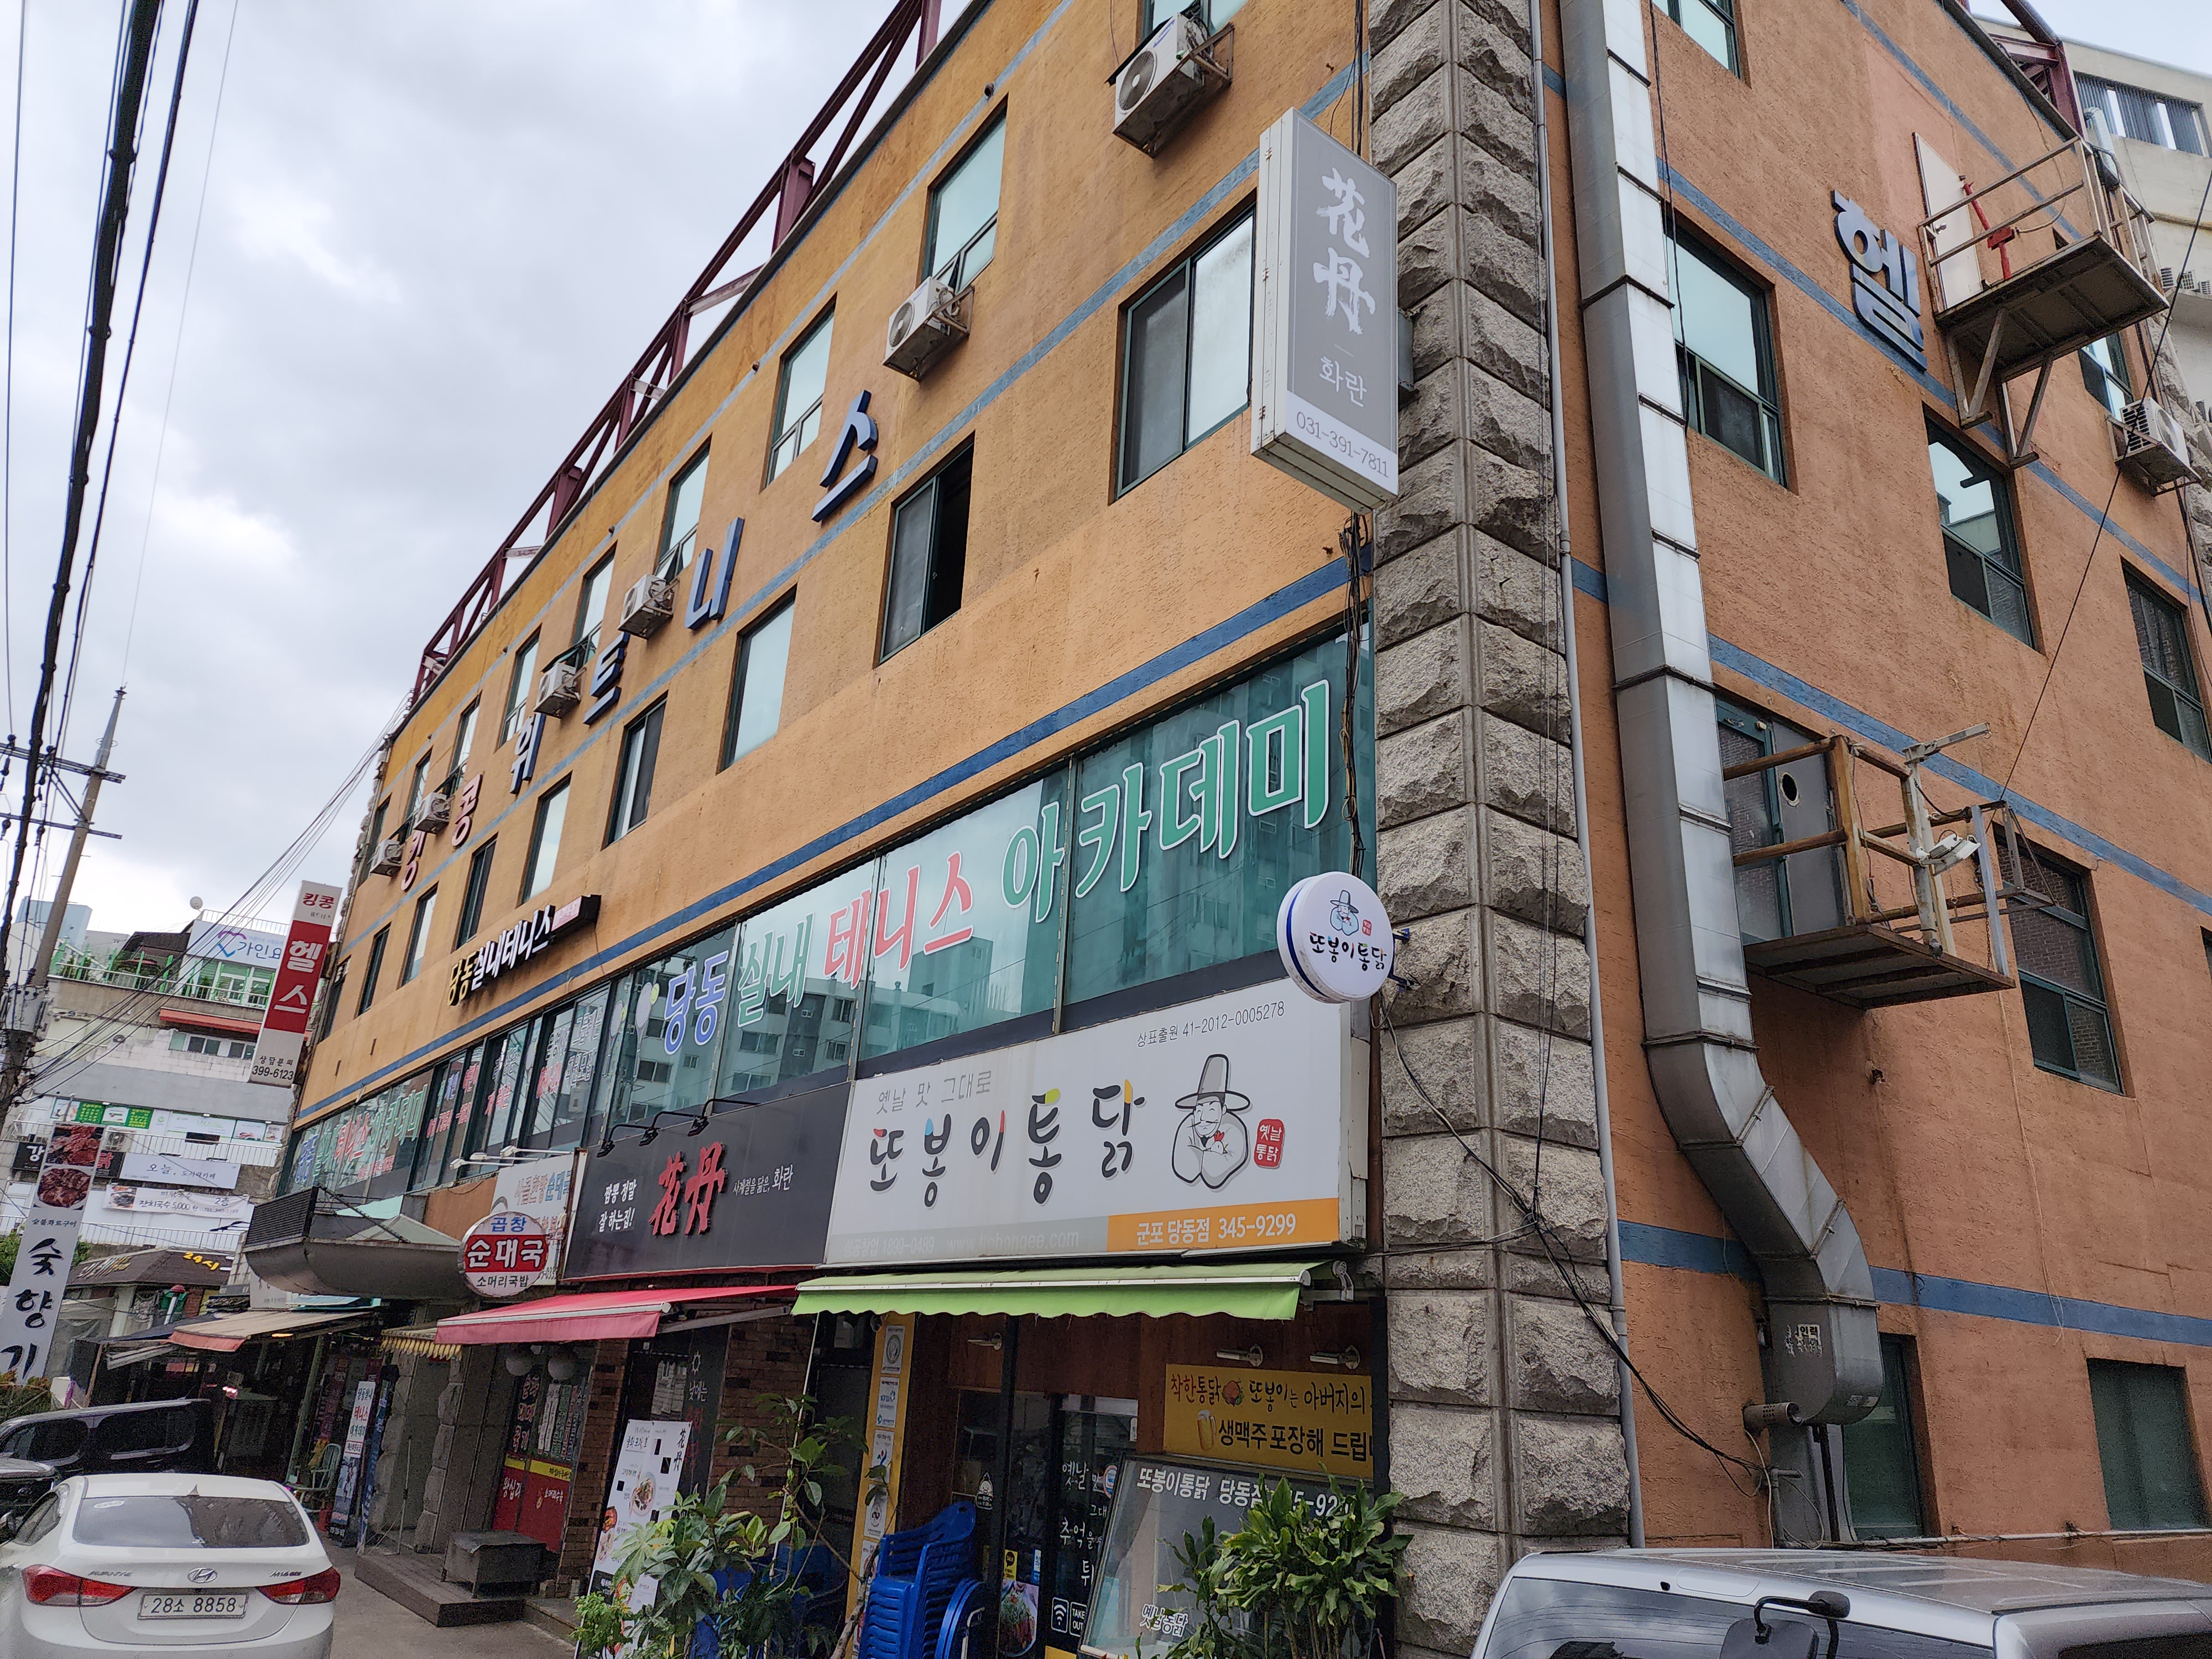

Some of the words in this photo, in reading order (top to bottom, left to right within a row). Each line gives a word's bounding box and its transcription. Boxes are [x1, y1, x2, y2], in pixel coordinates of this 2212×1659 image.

[1830, 189, 1927, 372] 헬
[1319, 356, 1367, 408] 화란
[1296, 411, 1390, 479] 031-391-7811
[664, 949, 729, 1055] 당동
[737, 911, 814, 1027] 실내
[823, 849, 974, 990] 테니스
[1001, 679, 1329, 924] 아카데미
[302, 892, 335, 910] 킹콩
[1309, 931, 1387, 972] 또봉이통닭
[273, 941, 324, 1014] 헬스
[1136, 1024, 1179, 1048] 상표출원
[1182, 1001, 1285, 1039] 41-2012-0005278
[252, 1065, 294, 1081] 399-6123
[259, 1055, 294, 1066] 상담문의
[876, 1087, 906, 1115] 옛날
[916, 1081, 931, 1108] 맛
[941, 1070, 993, 1104] 그대로
[1258, 1123, 1283, 1143] 옛날
[1255, 1143, 1279, 1164] 통닭
[604, 1183, 618, 1206] 짬뽕
[620, 1178, 638, 1203] 정말
[732, 1177, 757, 1196] 사계절을
[771, 1164, 794, 1191] 화란
[139, 1199, 172, 1209] 잔치국수
[172, 1202, 190, 1211] 5,000
[214, 1197, 230, 1207] 2층
[491, 1217, 527, 1233] 곱창
[1136, 1222, 1164, 1246] 군포
[1167, 1217, 1210, 1244] 당동점
[1218, 1213, 1297, 1240] 345-9299
[182, 1251, 220, 1271] 24시
[467, 1239, 545, 1269] 순대국
[476, 1274, 530, 1288] 소머리국밥
[1170, 1373, 1222, 1406] 착한통닭
[1249, 1379, 1298, 1413] 또봉이는
[1304, 1381, 1365, 1415] 아버지의
[354, 1405, 369, 1422] 테니스
[1218, 1420, 1267, 1451] 생맥주
[1269, 1424, 1324, 1458] 포장해
[1062, 1460, 1089, 1490] 옛날
[1136, 1467, 1211, 1501] 또봉이통닭
[1060, 1516, 1094, 1550] 추억을
[150, 1597, 185, 1614] 28소
[192, 1597, 237, 1614] 8858
[1071, 1608, 1086, 1620] TAKE
[1072, 1620, 1084, 1631] OUT
